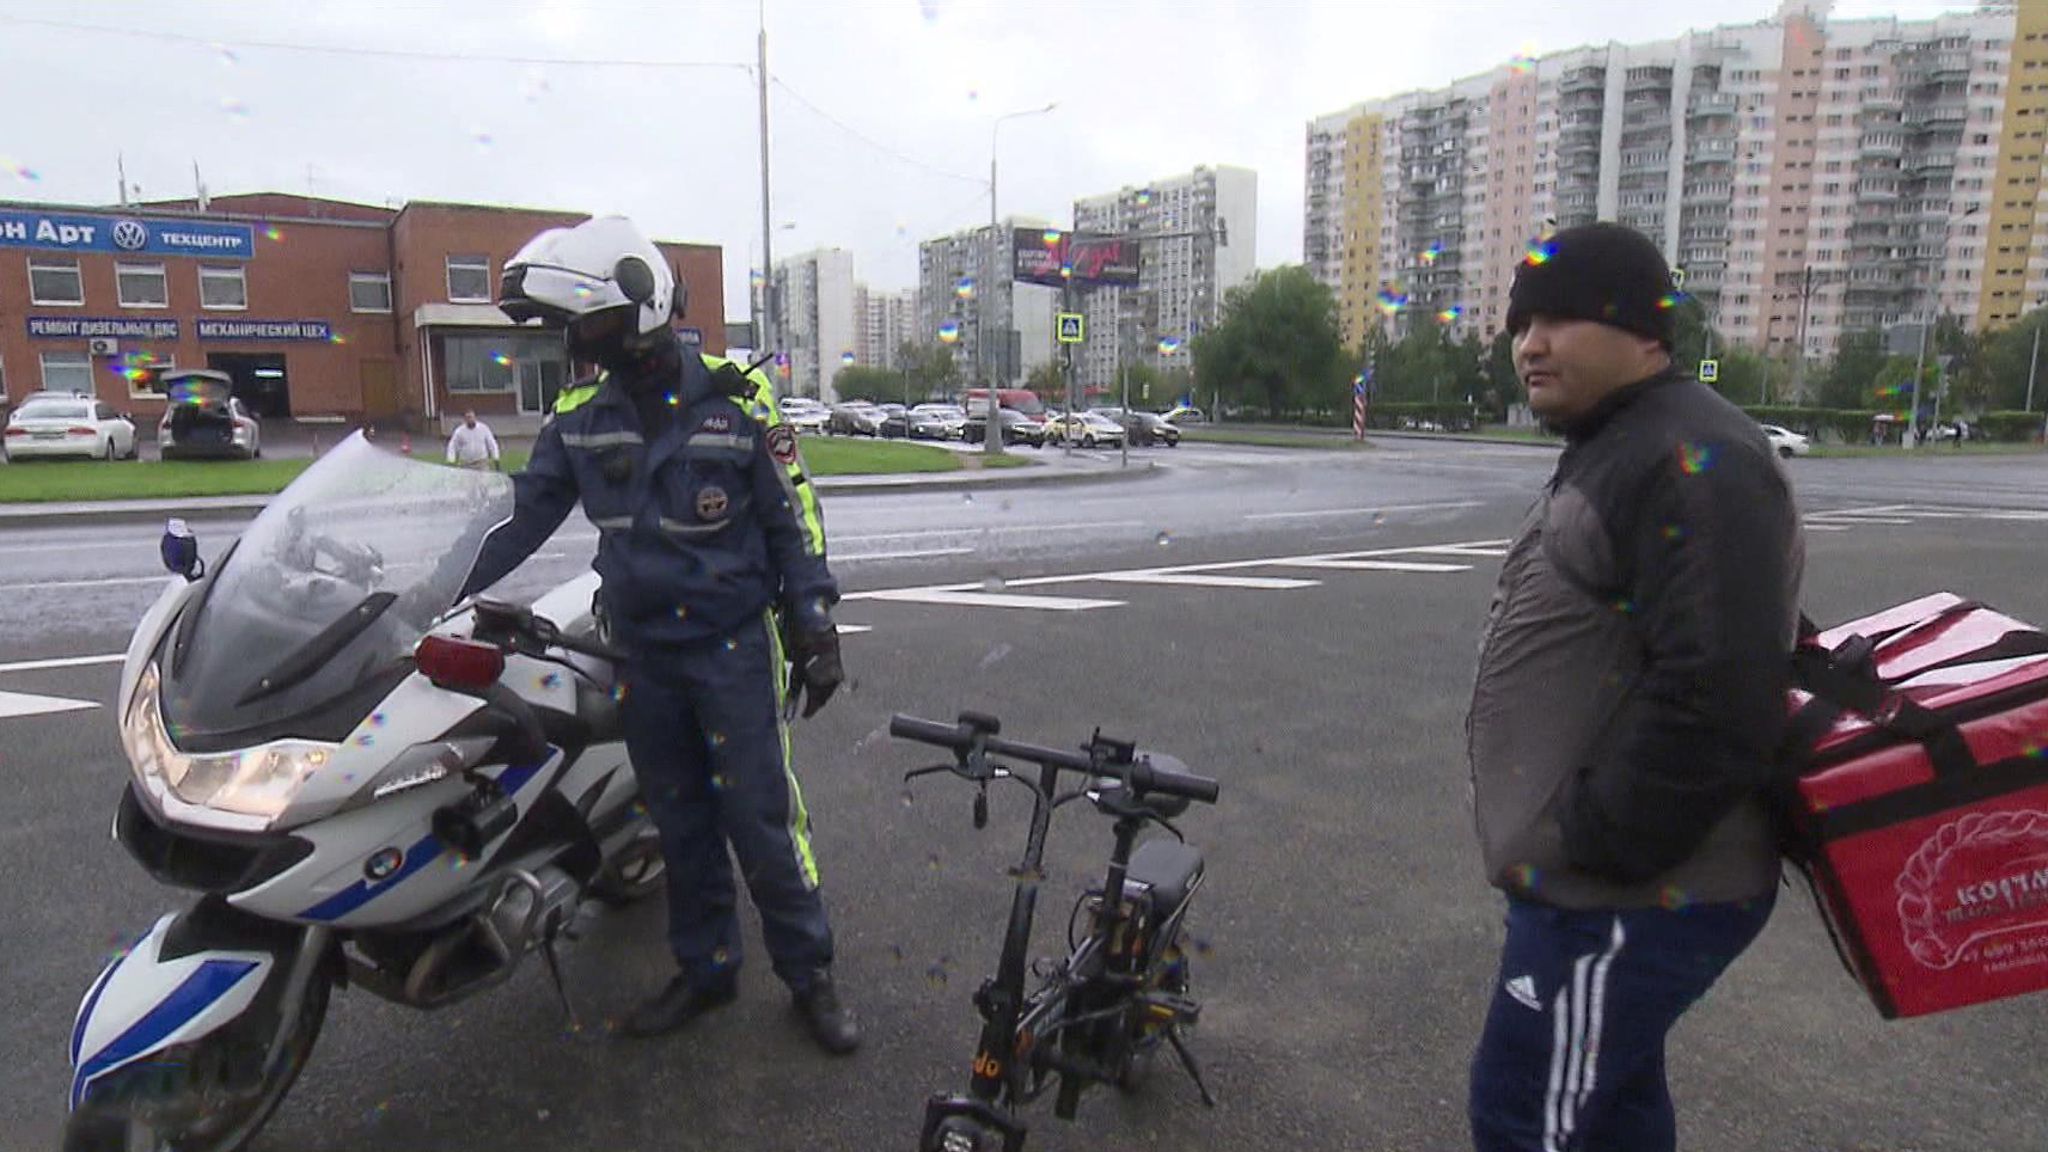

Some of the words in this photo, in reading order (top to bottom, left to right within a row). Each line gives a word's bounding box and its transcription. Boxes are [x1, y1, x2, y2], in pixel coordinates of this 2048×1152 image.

[36, 219, 95, 244] Арт
[161, 232, 242, 249] ТЕХЦЕНТР
[30, 321, 79, 335] РЕМОНТ
[80, 322, 152, 337] ДИЗЕЛЬНЫХ
[199, 322, 300, 337] МЕХАНИЧЕСКИЙ
[301, 323, 328, 339] ЦЕХ
